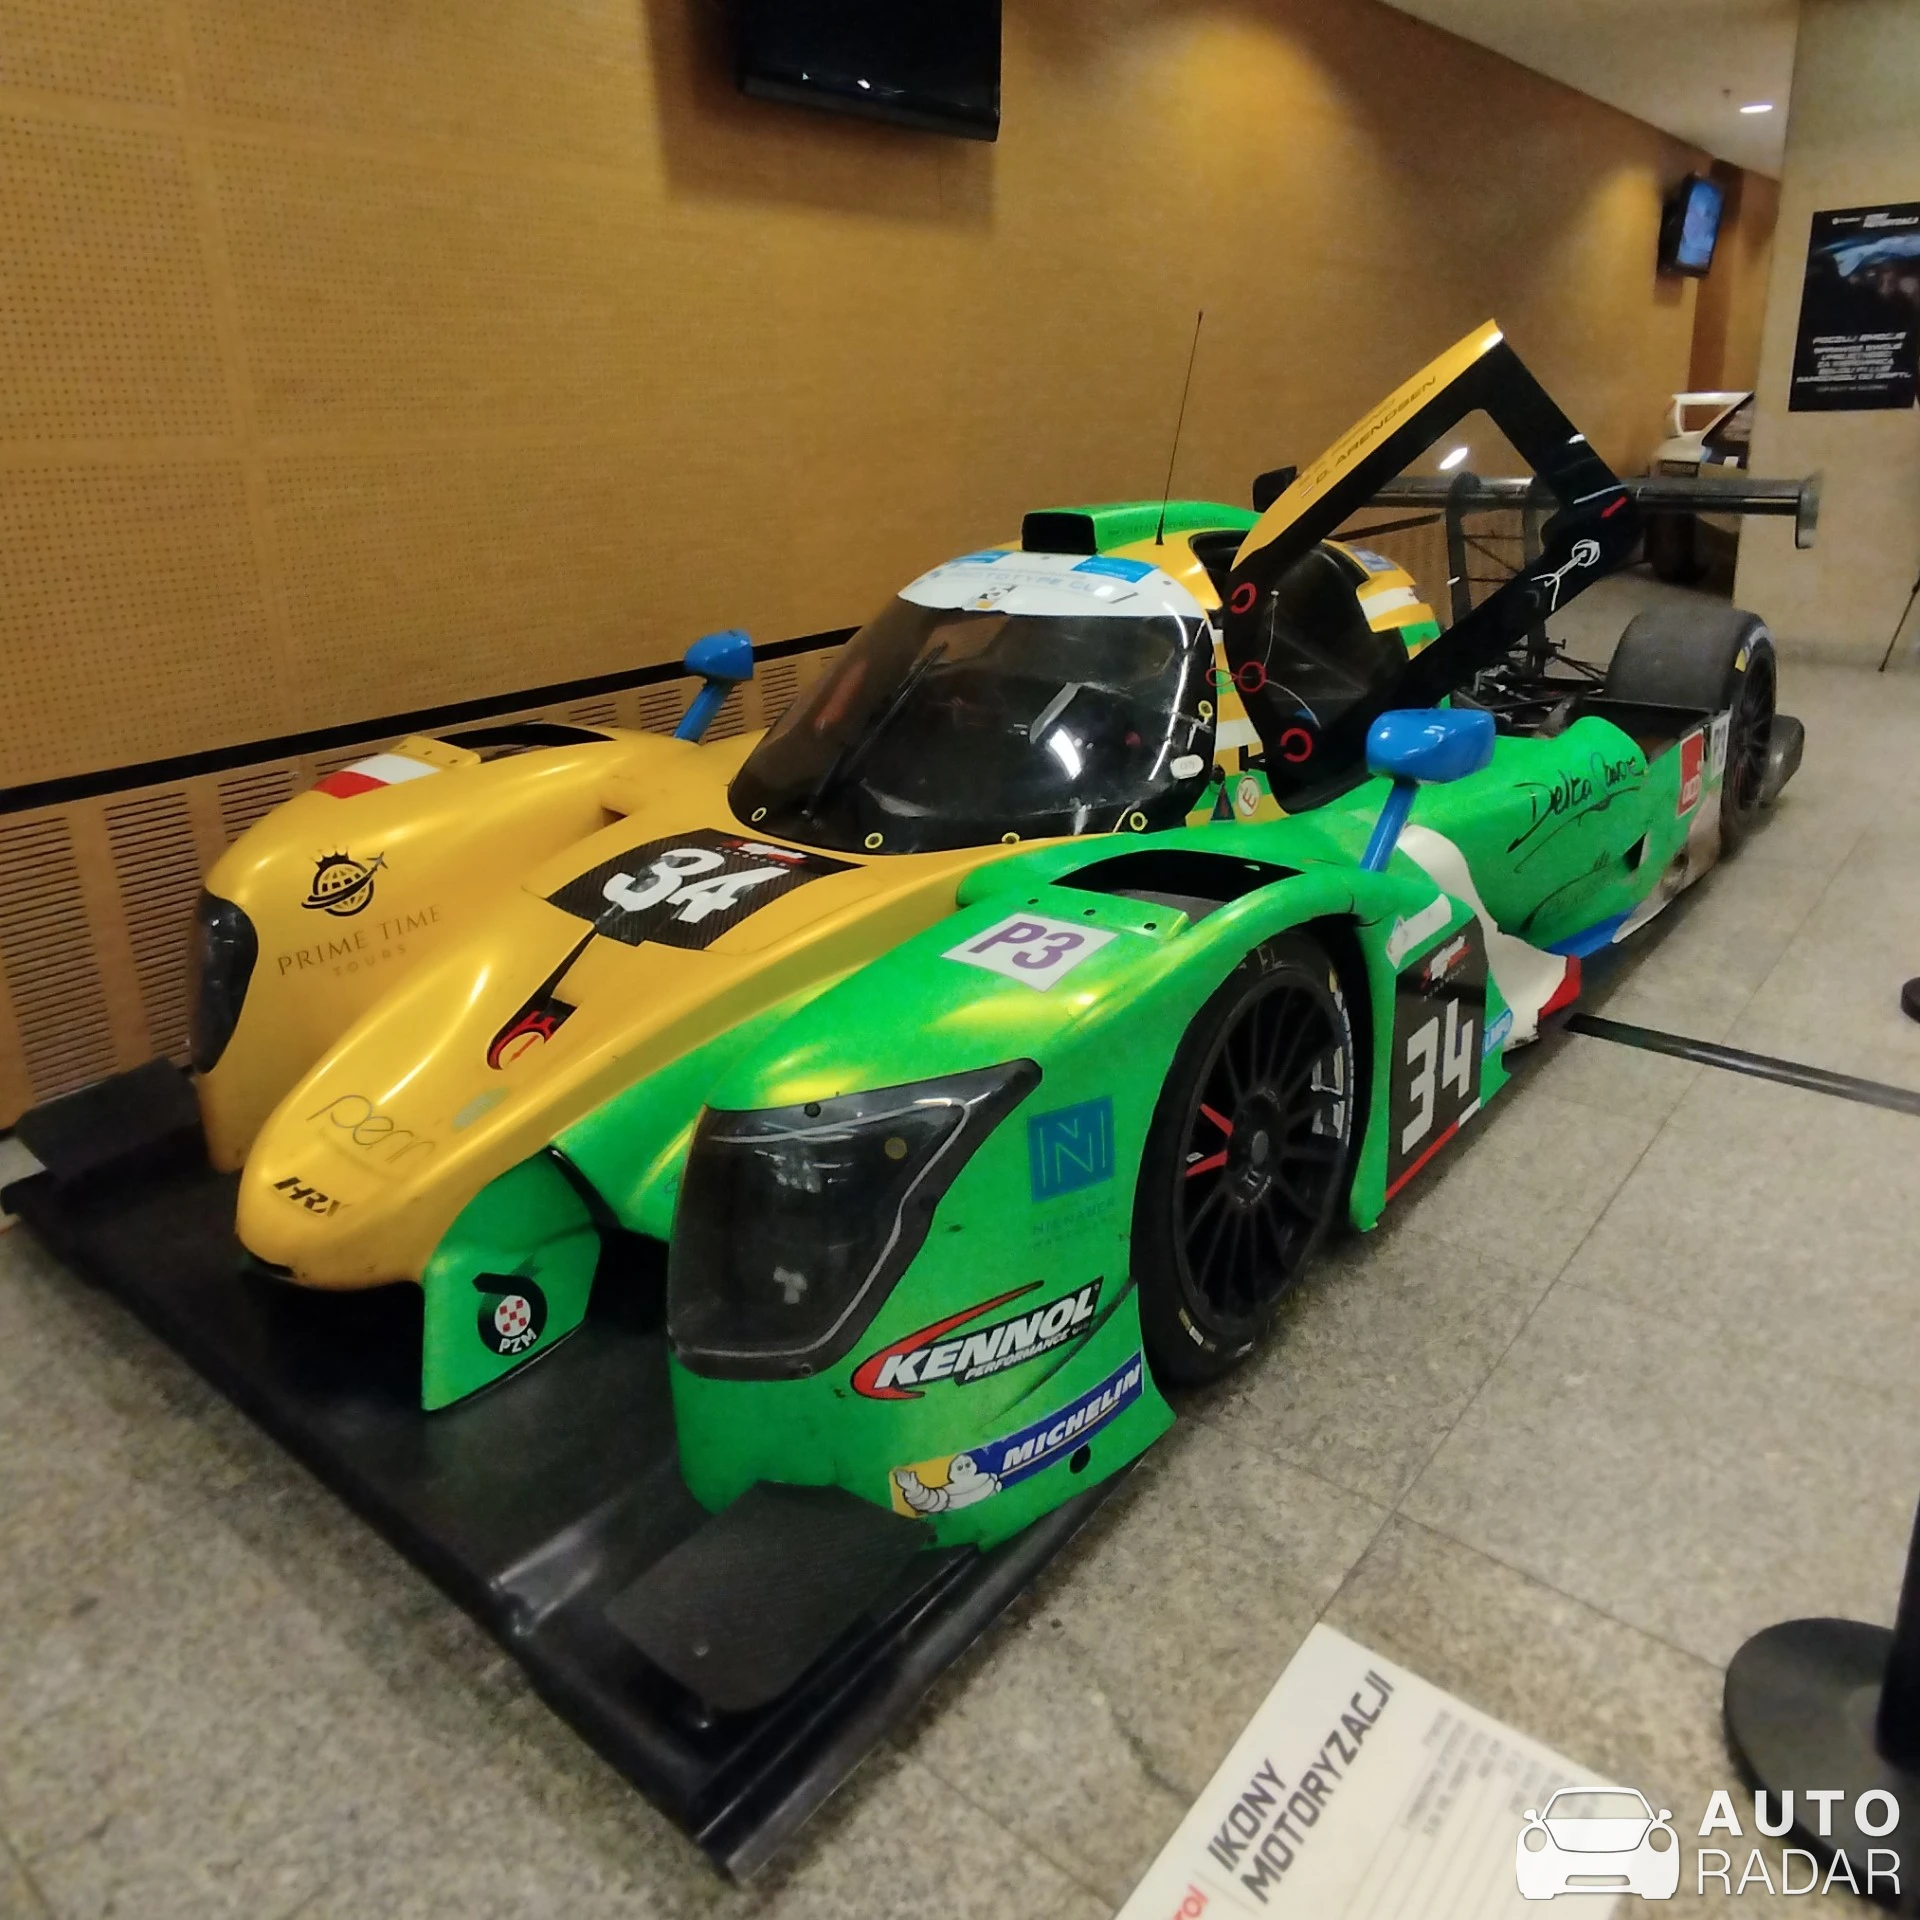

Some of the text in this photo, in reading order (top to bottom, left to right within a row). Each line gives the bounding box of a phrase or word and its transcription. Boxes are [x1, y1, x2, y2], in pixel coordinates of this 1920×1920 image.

[602, 848, 790, 923] 34
[276, 905, 442, 977] PRIME TIME
[332, 944, 407, 979] TOURS
[967, 921, 1085, 970] P3
[1401, 998, 1474, 1155] 34
[499, 1328, 537, 1354] PZM
[873, 1286, 1094, 1389] KENNOL
[1003, 1363, 1141, 1470] MICHELIN
[1207, 1757, 1287, 1872] IKONY
[1240, 1669, 1395, 1905] MOTORYZACJI
